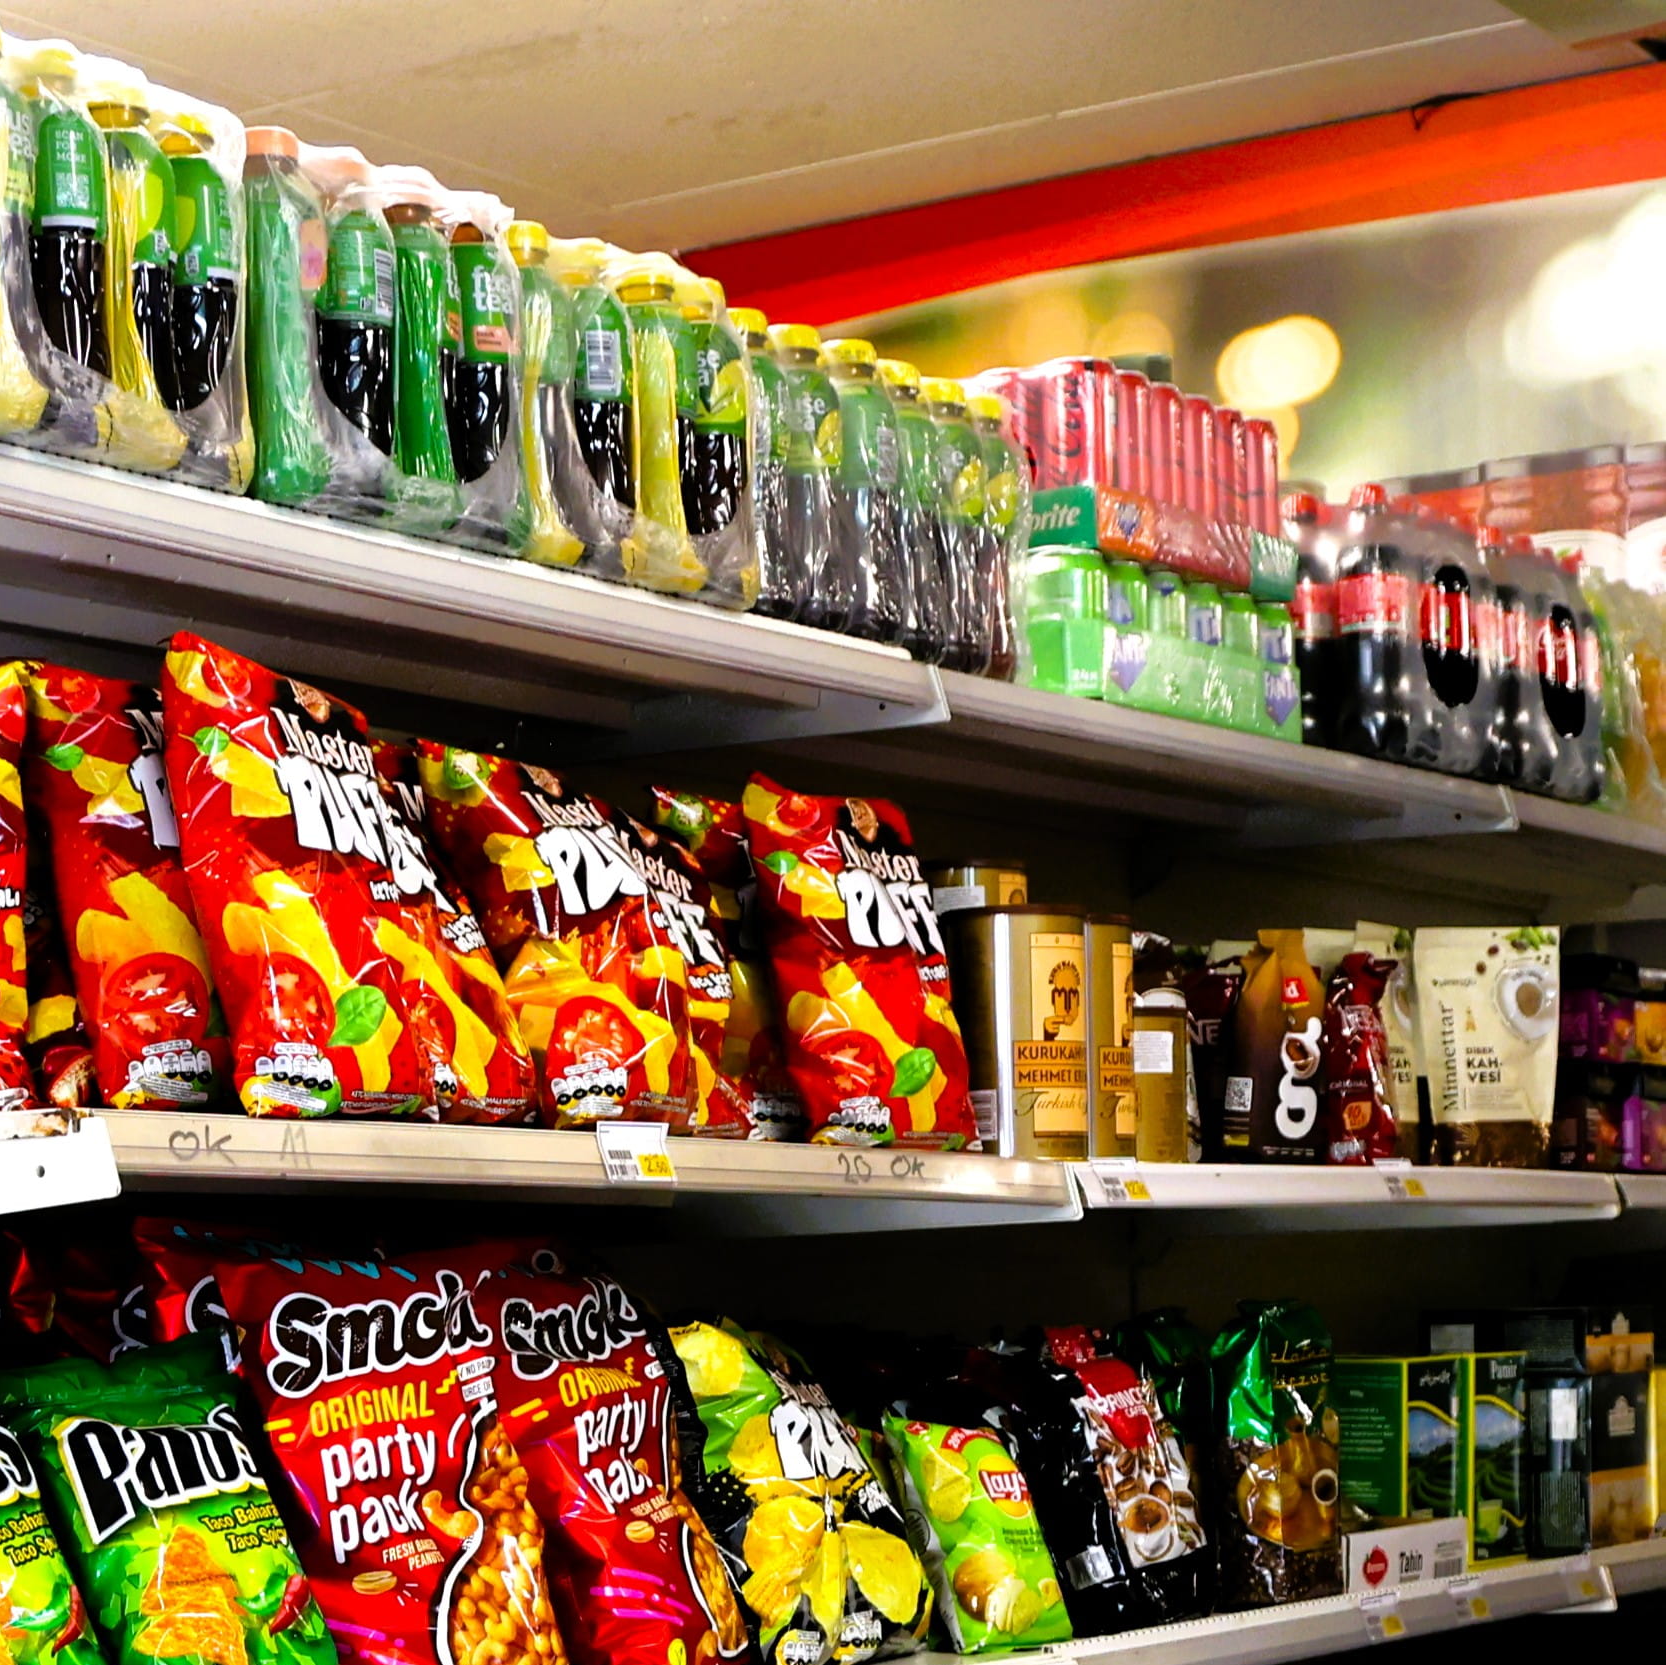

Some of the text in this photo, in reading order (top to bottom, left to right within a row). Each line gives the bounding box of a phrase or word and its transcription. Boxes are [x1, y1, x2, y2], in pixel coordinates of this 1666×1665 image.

[270, 706, 376, 779] Master
[309, 1380, 435, 1438] ORIGINAL
[573, 1391, 647, 1467] party
[320, 1423, 437, 1503] party
[201, 1511, 234, 1533] Taco
[227, 1532, 260, 1552] Taco
[329, 1477, 426, 1564] pack
[6, 1544, 38, 1566] Taco
[381, 1544, 415, 1564] FRESH
